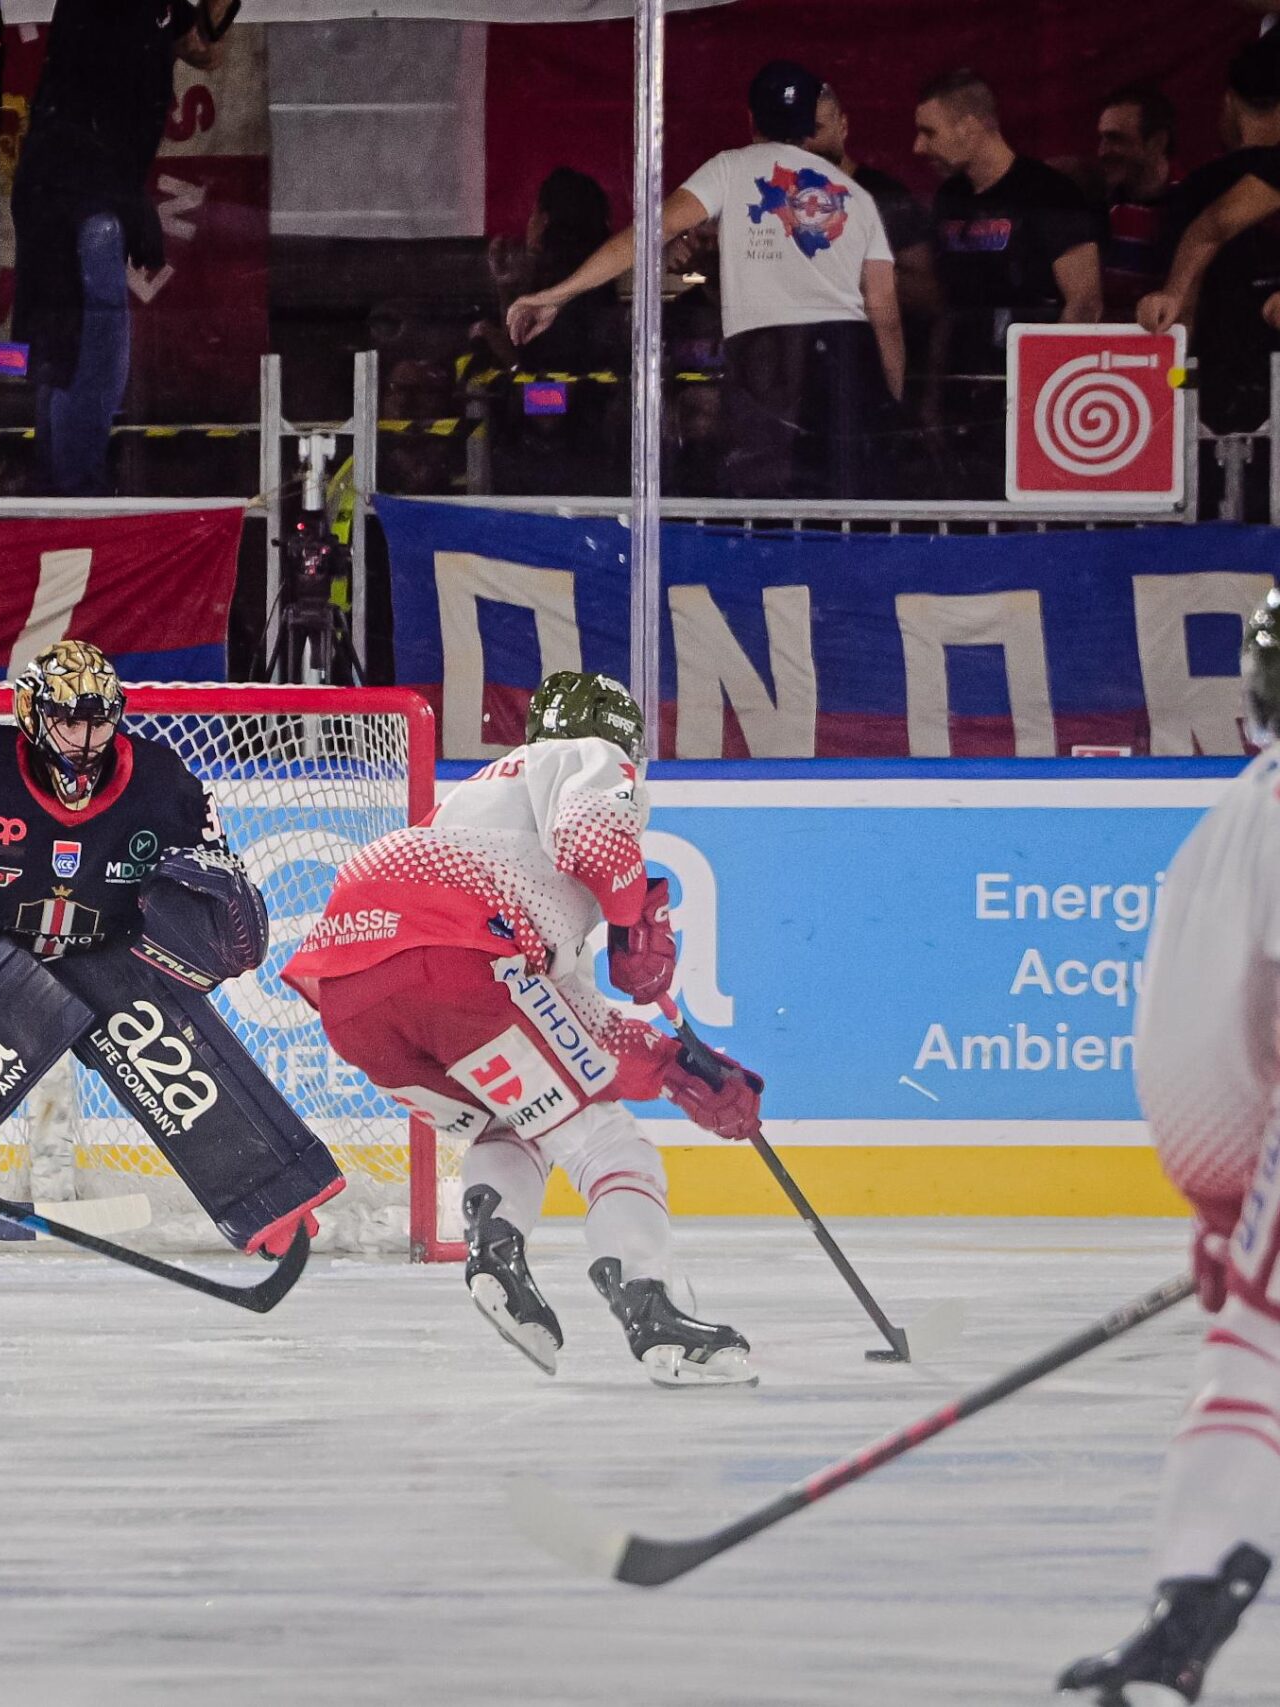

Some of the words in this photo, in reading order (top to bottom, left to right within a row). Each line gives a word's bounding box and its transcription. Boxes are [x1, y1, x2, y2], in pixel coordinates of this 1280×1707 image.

[310, 908, 401, 942] ARKASSE
[142, 943, 214, 987] TRUE
[90, 1028, 122, 1067] LIFE
[116, 1058, 181, 1138] COMPANY
[107, 1000, 218, 1131] a2a
